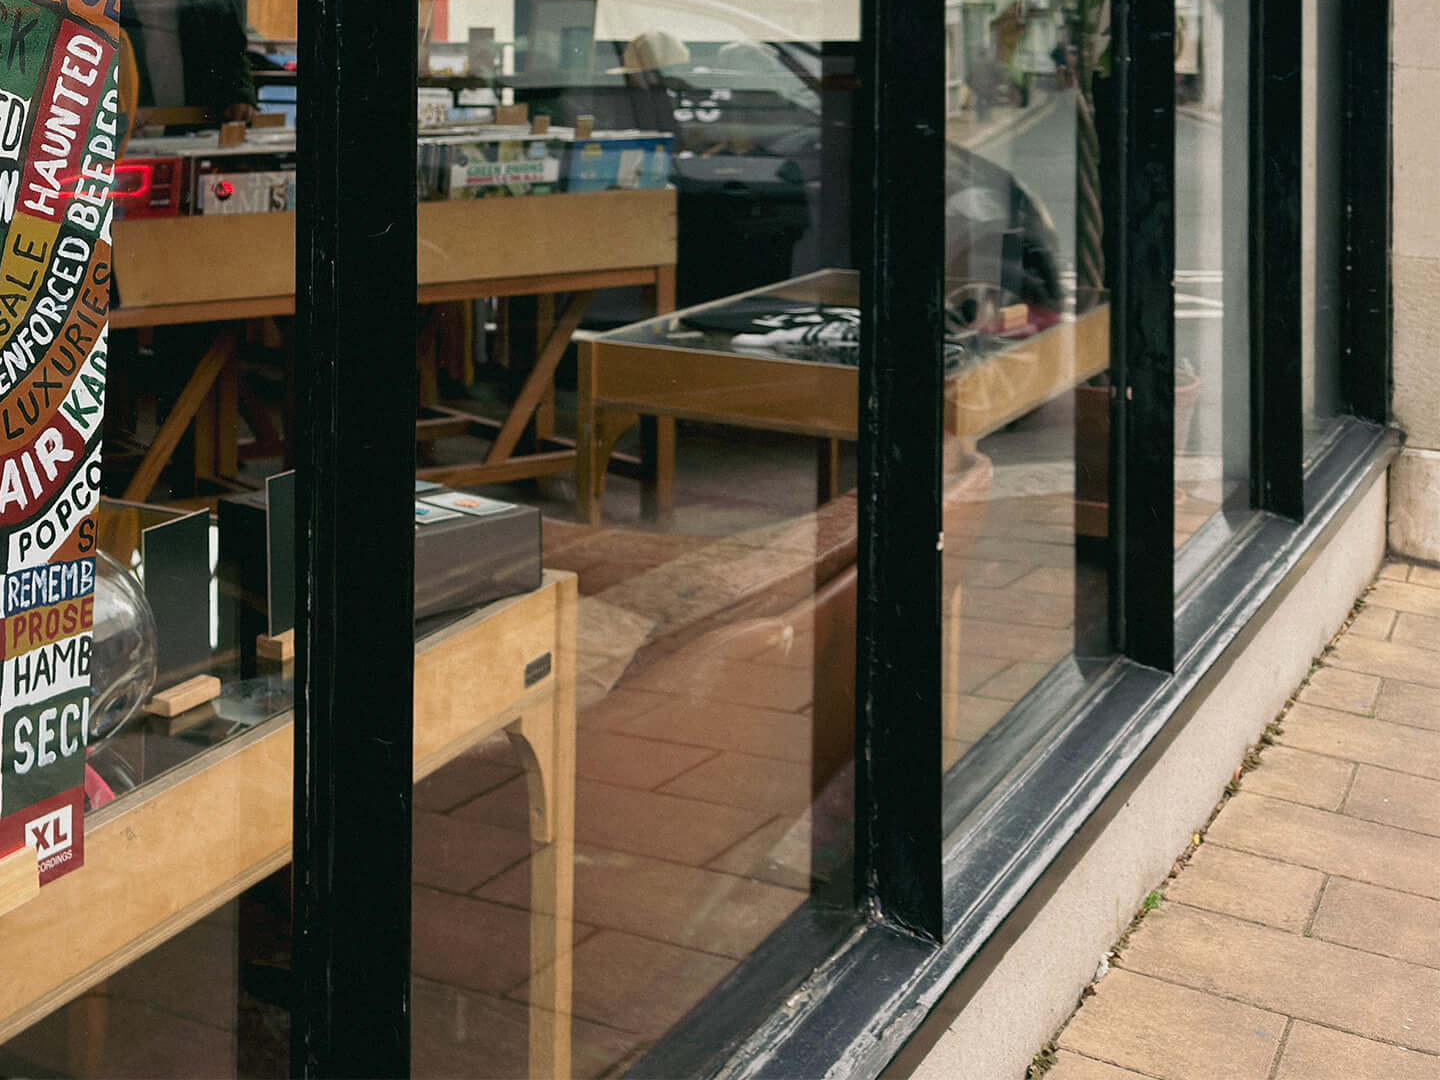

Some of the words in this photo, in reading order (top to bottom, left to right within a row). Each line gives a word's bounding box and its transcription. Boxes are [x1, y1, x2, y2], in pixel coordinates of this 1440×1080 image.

[24, 34, 104, 216] HAUNTED
[67, 65, 119, 231] BEEPE
[7, 560, 95, 614] REMEMB
[12, 596, 94, 649] PROSE
[14, 635, 92, 698] HAMB
[31, 817, 67, 851] XL
[38, 849, 72, 872] ORDINGS
